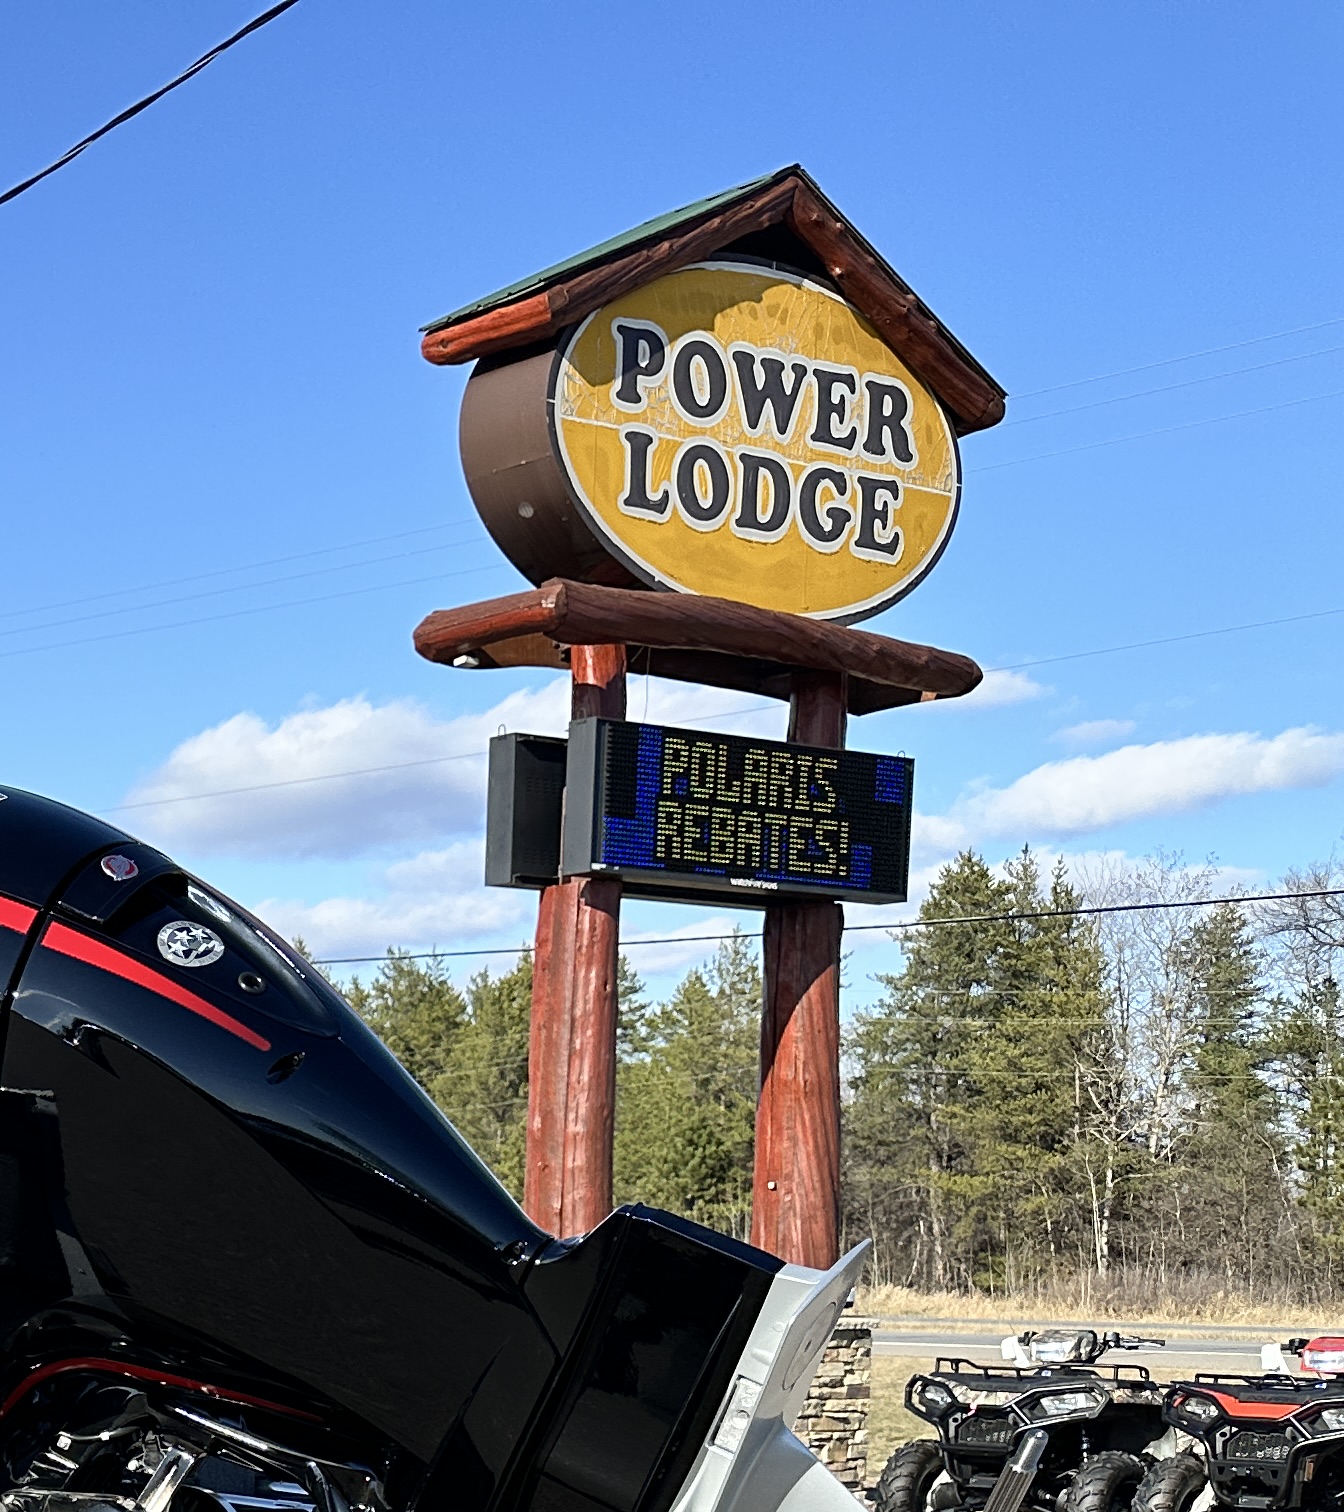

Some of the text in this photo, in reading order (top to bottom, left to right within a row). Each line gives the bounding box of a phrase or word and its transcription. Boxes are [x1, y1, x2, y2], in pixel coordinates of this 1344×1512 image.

[614, 322, 915, 464] POWER
[621, 428, 902, 558] LODGE
[662, 736, 839, 814] POLARIS
[655, 799, 850, 876] REBATES!
